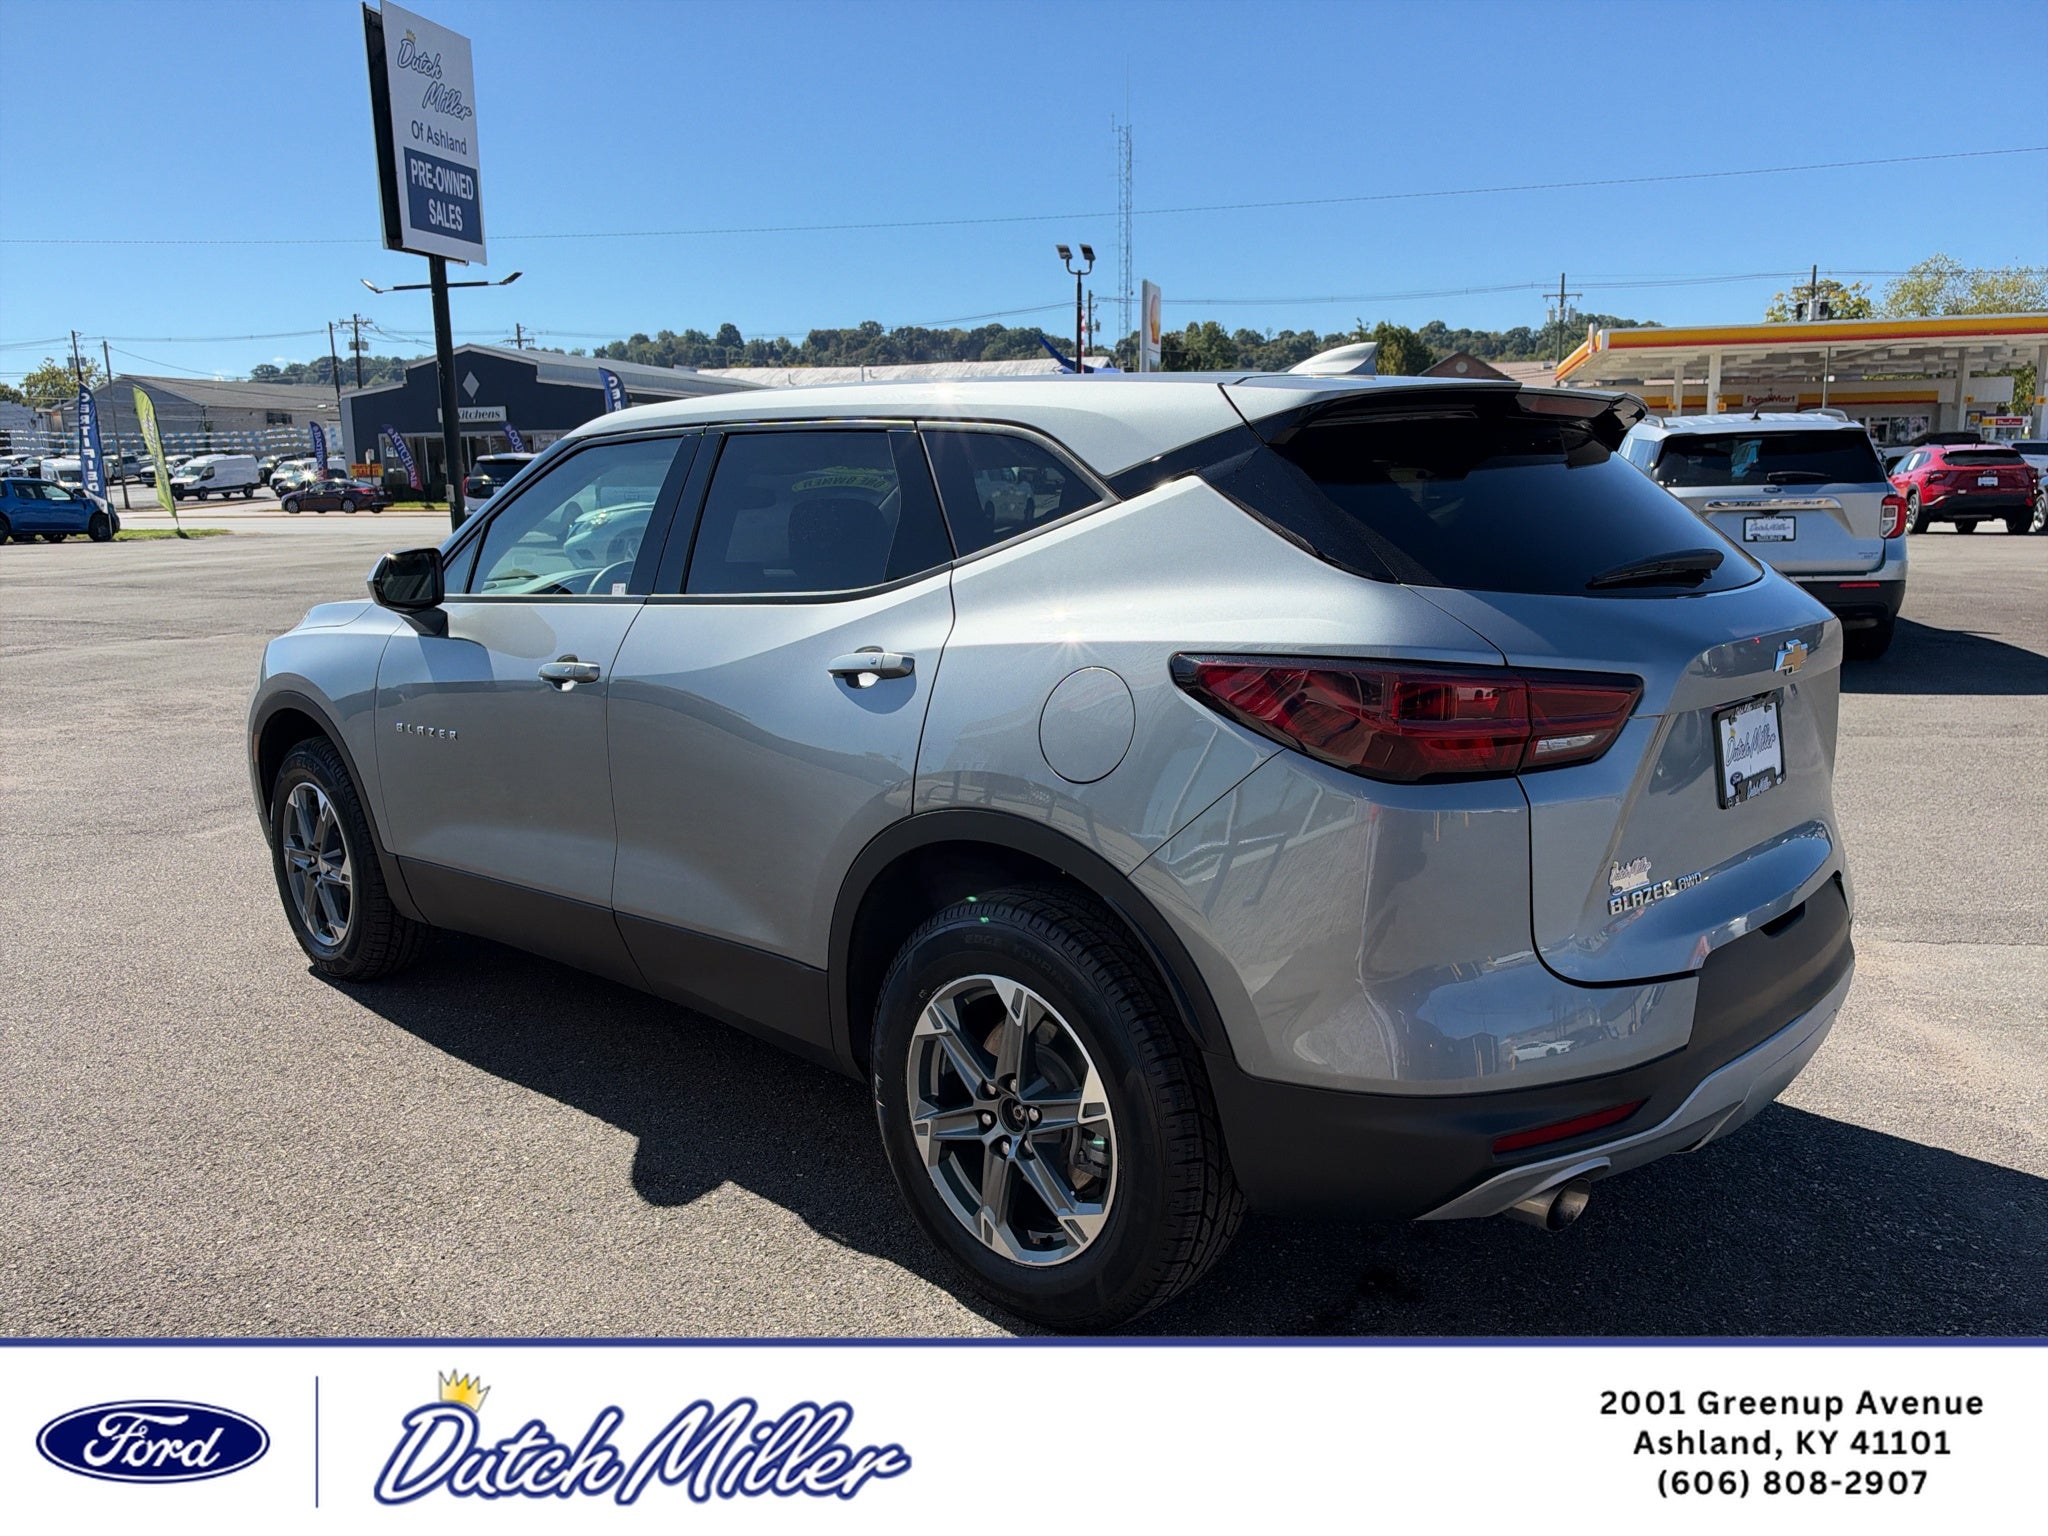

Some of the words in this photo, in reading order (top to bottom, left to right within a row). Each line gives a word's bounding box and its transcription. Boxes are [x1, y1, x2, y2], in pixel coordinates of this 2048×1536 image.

[397, 38, 442, 80] Dutch
[422, 80, 472, 120] Miller
[411, 120, 424, 140] Of
[426, 131, 467, 156] Ashland
[410, 158, 474, 201] PRE-OWNED
[428, 199, 463, 232] SALES
[458, 409, 501, 421] itchens
[396, 722, 458, 740] BLAZER
[1726, 732, 1752, 767] Dutch
[1750, 723, 1777, 757] Miller
[1608, 880, 1672, 915] BLAZER
[1677, 872, 1702, 892] AWD
